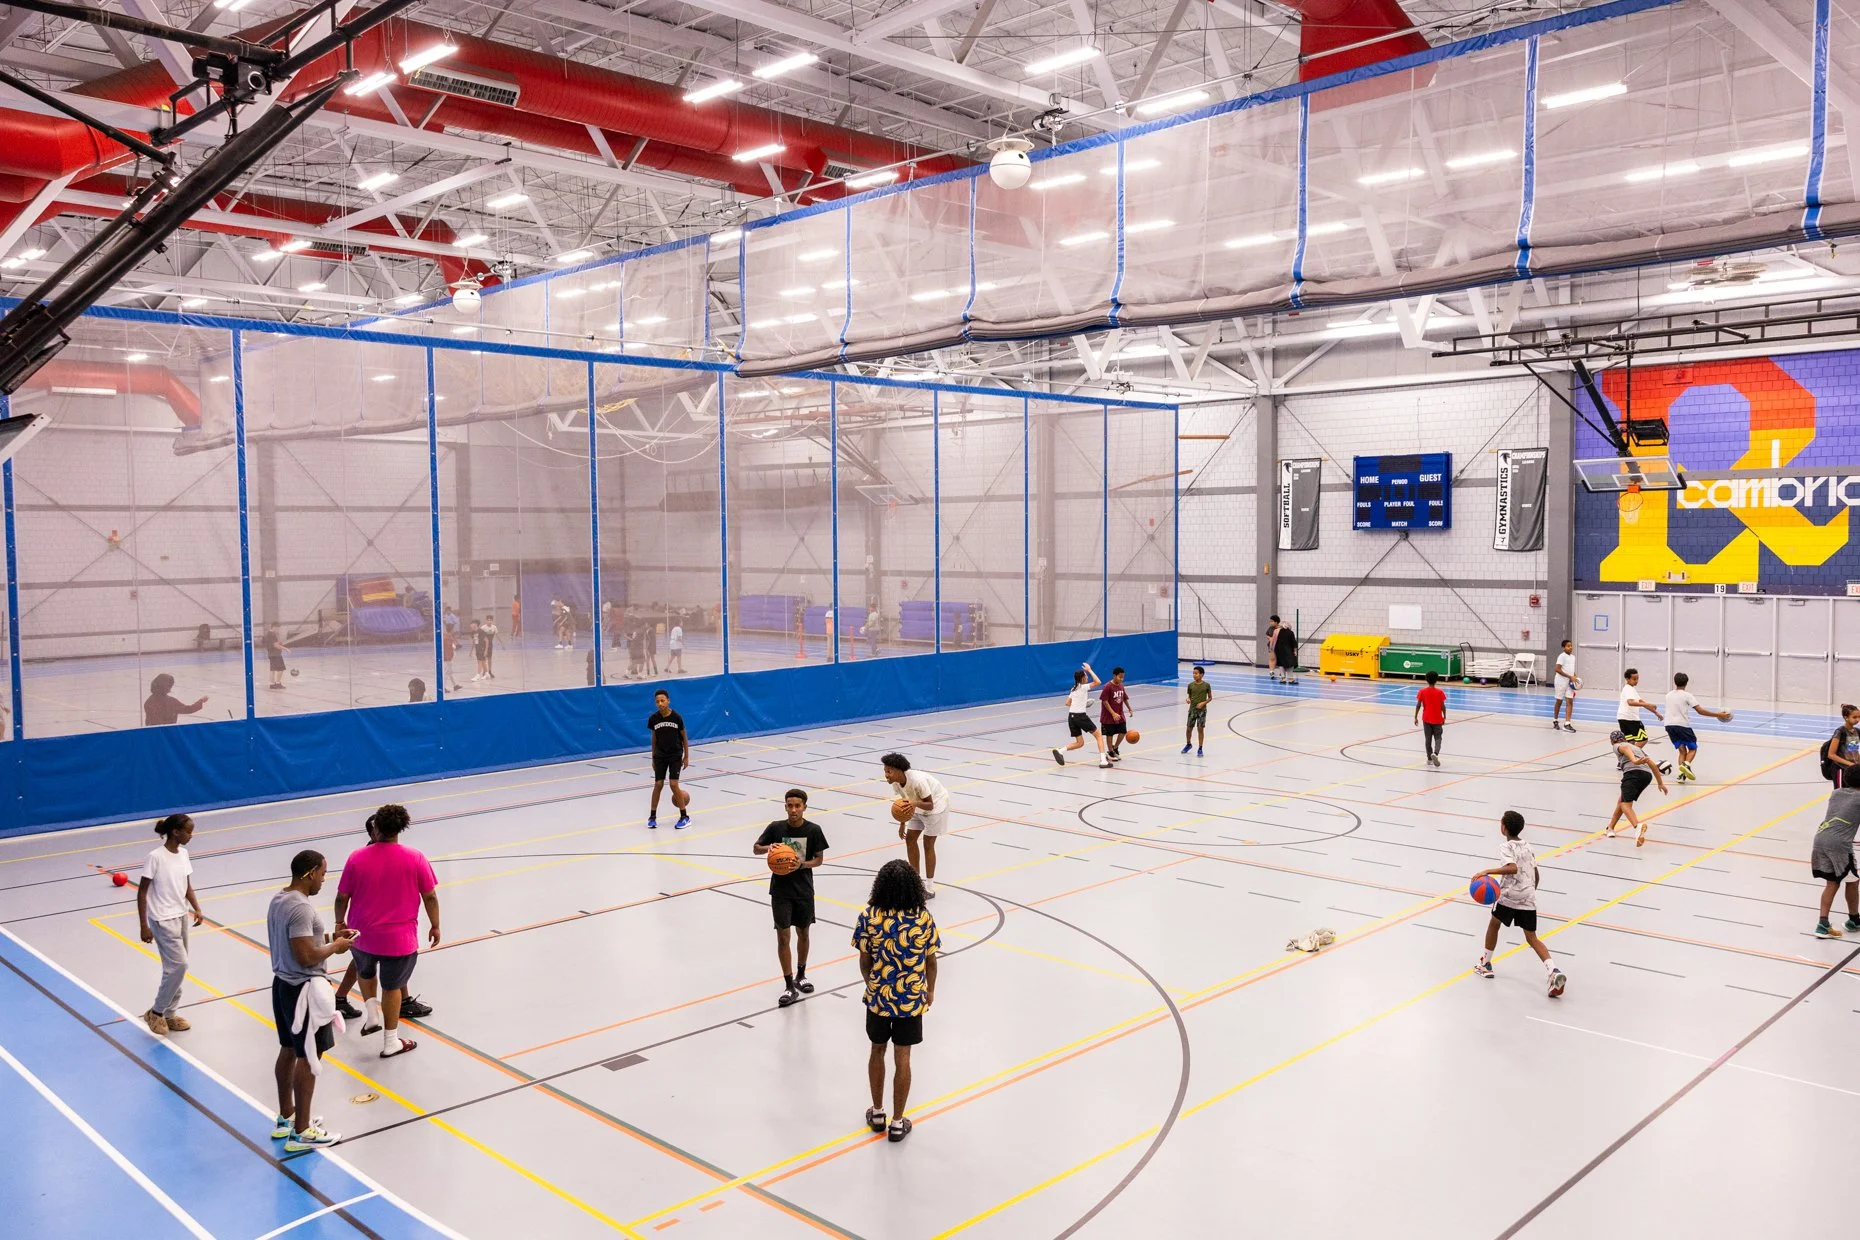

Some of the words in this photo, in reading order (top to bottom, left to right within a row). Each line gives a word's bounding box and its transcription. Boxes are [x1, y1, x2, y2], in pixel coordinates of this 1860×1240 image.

[1360, 476, 1379, 484] HOME
[1419, 474, 1442, 482] GUEST
[1499, 467, 1508, 534] GYMNASTICS
[1283, 483, 1291, 529] SOFTBALL
[1641, 581, 1653, 589] EXIT
[1715, 585, 1725, 593] 19
[1742, 583, 1754, 591] EXIT
